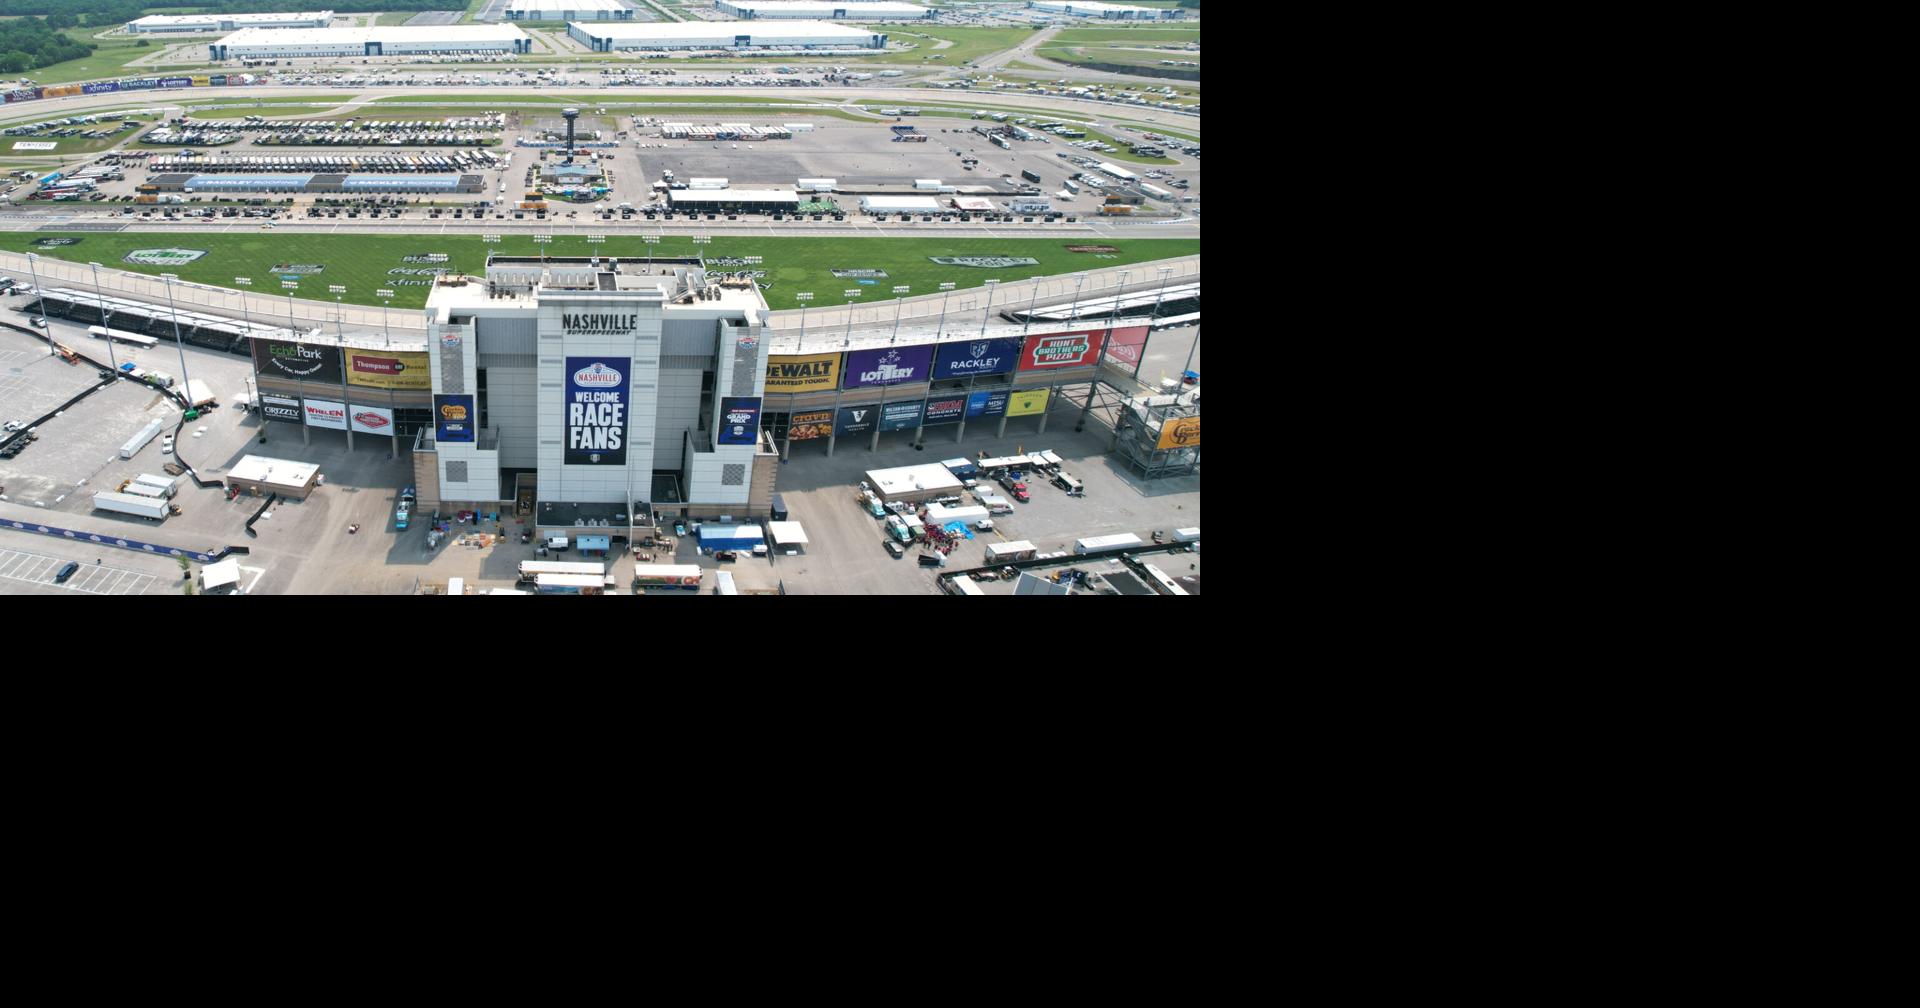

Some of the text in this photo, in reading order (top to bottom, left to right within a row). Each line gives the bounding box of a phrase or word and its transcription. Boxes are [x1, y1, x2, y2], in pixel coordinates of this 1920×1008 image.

[89, 84, 113, 92] xfinity
[562, 313, 638, 330] NASHVILLE
[1038, 344, 1085, 354] BROTHERS
[1049, 339, 1077, 348] HUNT
[1046, 352, 1074, 361] PIZZA
[356, 360, 390, 370] Thompson
[766, 360, 833, 377] EWALT
[950, 357, 1001, 370] RACKLEY
[578, 373, 617, 382] NASHVILLE
[860, 364, 914, 382] LOTTERY
[575, 391, 620, 403] WELCOME
[264, 406, 299, 417] GRIZZLY
[569, 402, 624, 427] RACE
[570, 426, 622, 450] FANS
